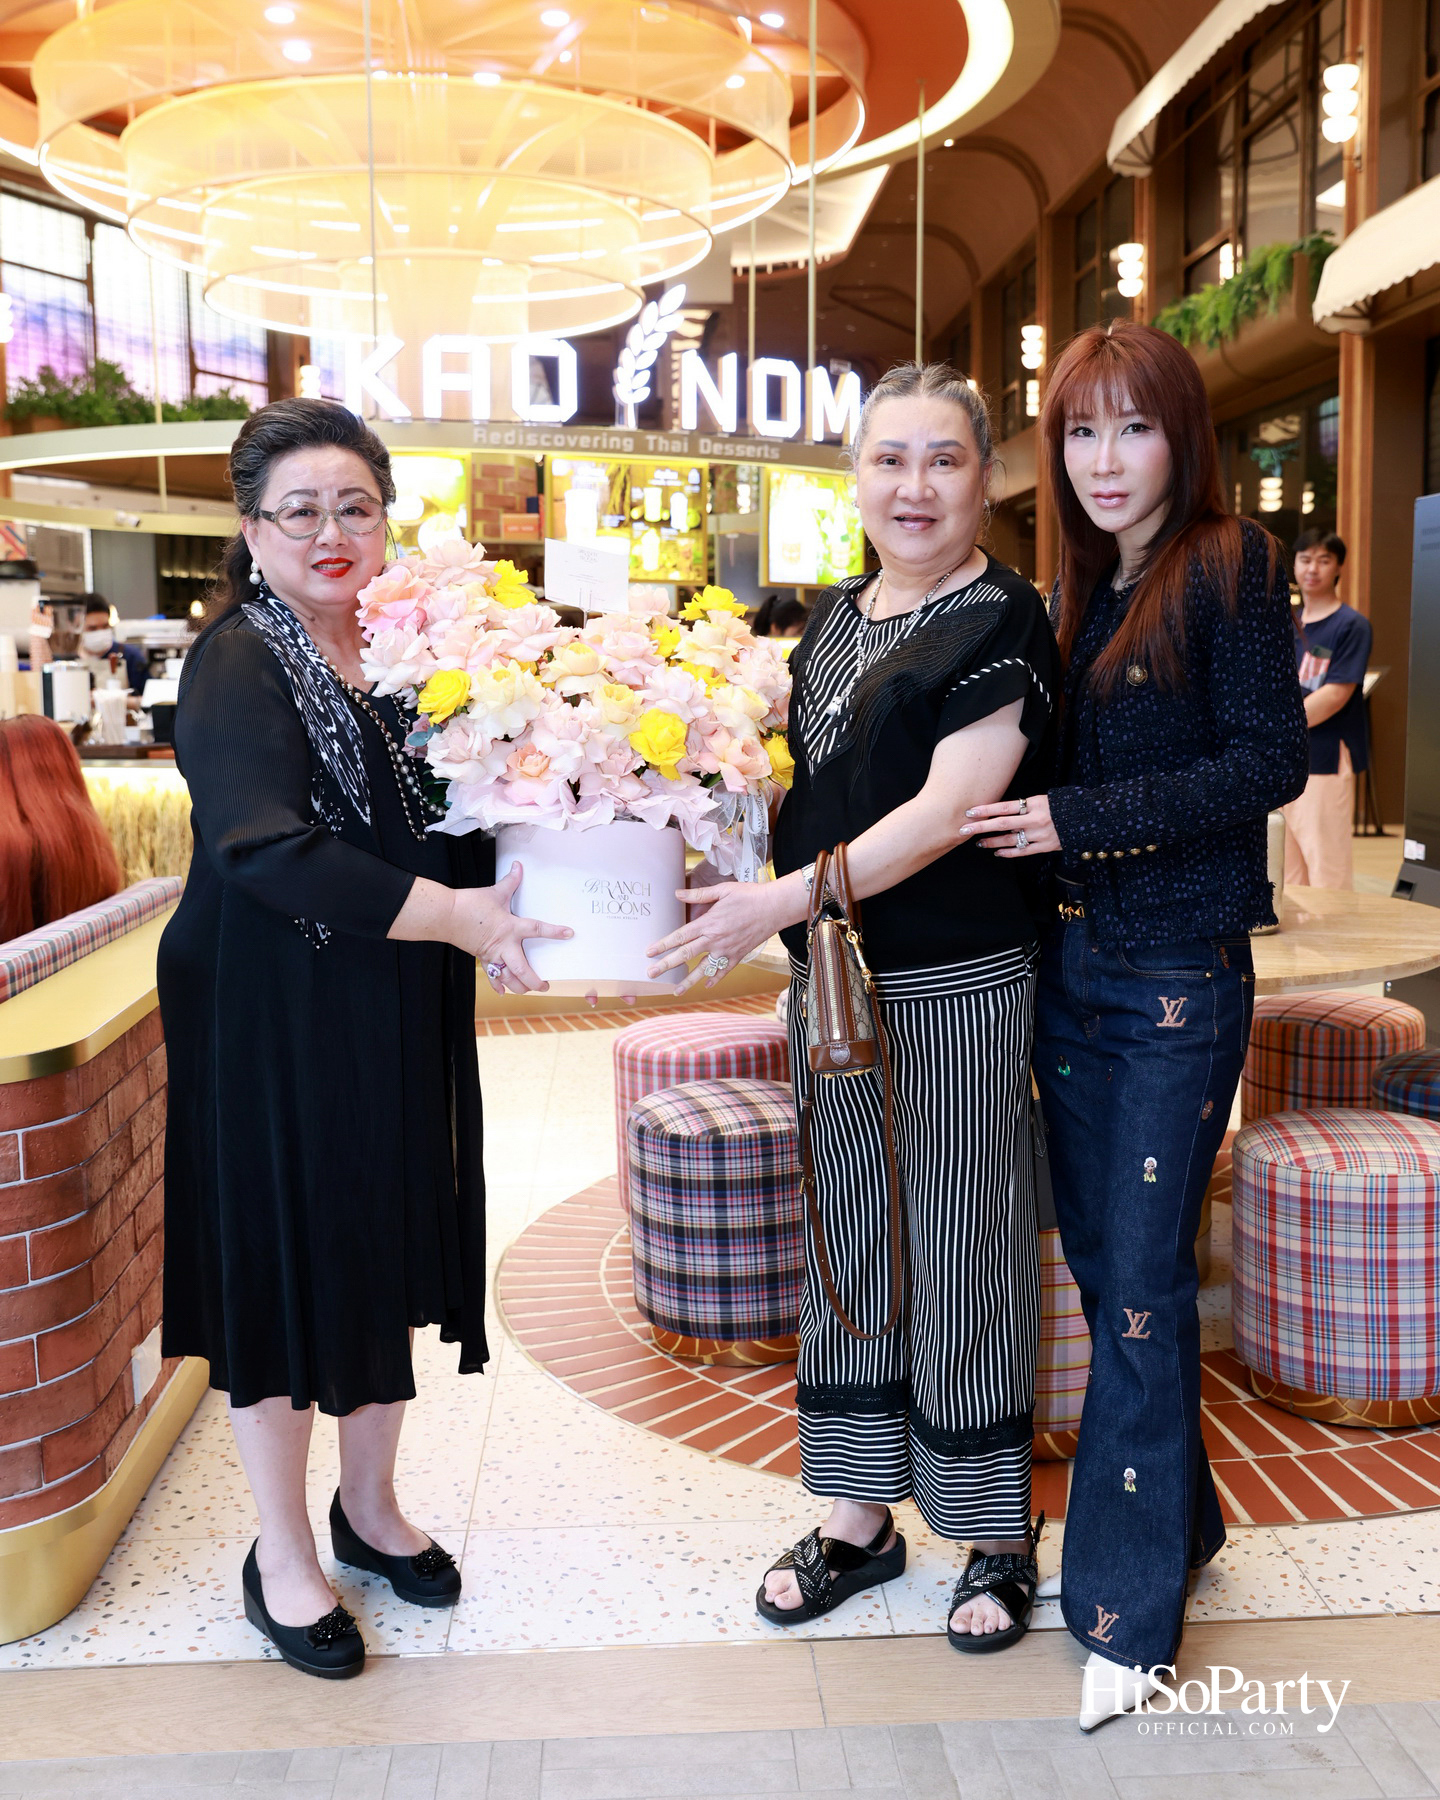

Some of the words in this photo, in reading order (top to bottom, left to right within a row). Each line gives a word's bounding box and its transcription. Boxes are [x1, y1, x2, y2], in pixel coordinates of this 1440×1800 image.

[344, 334, 577, 422] KAO
[681, 349, 862, 447] NOM
[473, 427, 634, 452] Rediscovering
[646, 435, 689, 454] Thai
[699, 438, 780, 460] Desserts
[584, 878, 651, 899] BRANCH
[591, 900, 651, 916] BLOOMS
